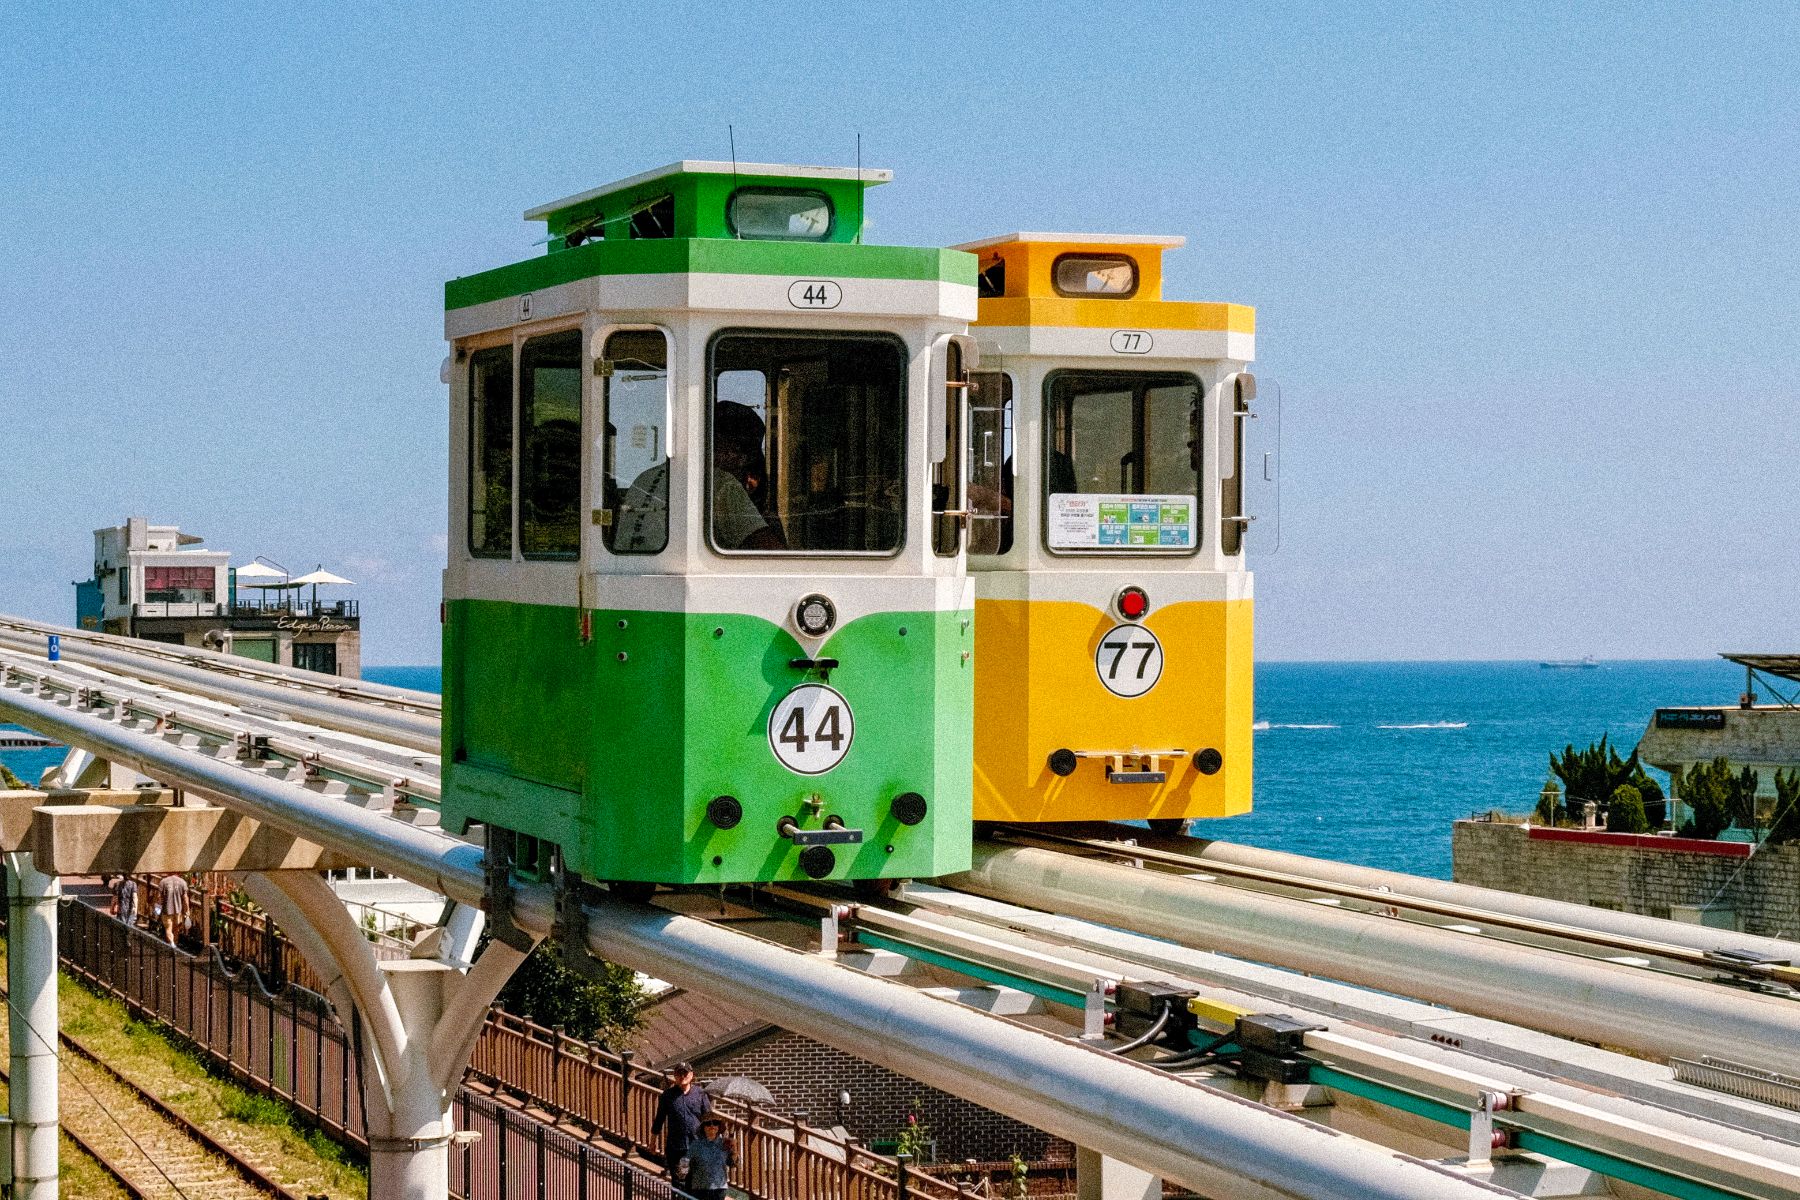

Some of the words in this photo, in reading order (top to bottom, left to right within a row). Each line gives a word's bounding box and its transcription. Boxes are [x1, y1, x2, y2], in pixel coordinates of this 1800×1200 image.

[803, 284, 828, 305] 44
[522, 298, 530, 316] 44
[1122, 333, 1141, 350] 77
[1103, 642, 1156, 680] 77
[779, 705, 845, 753] 44
